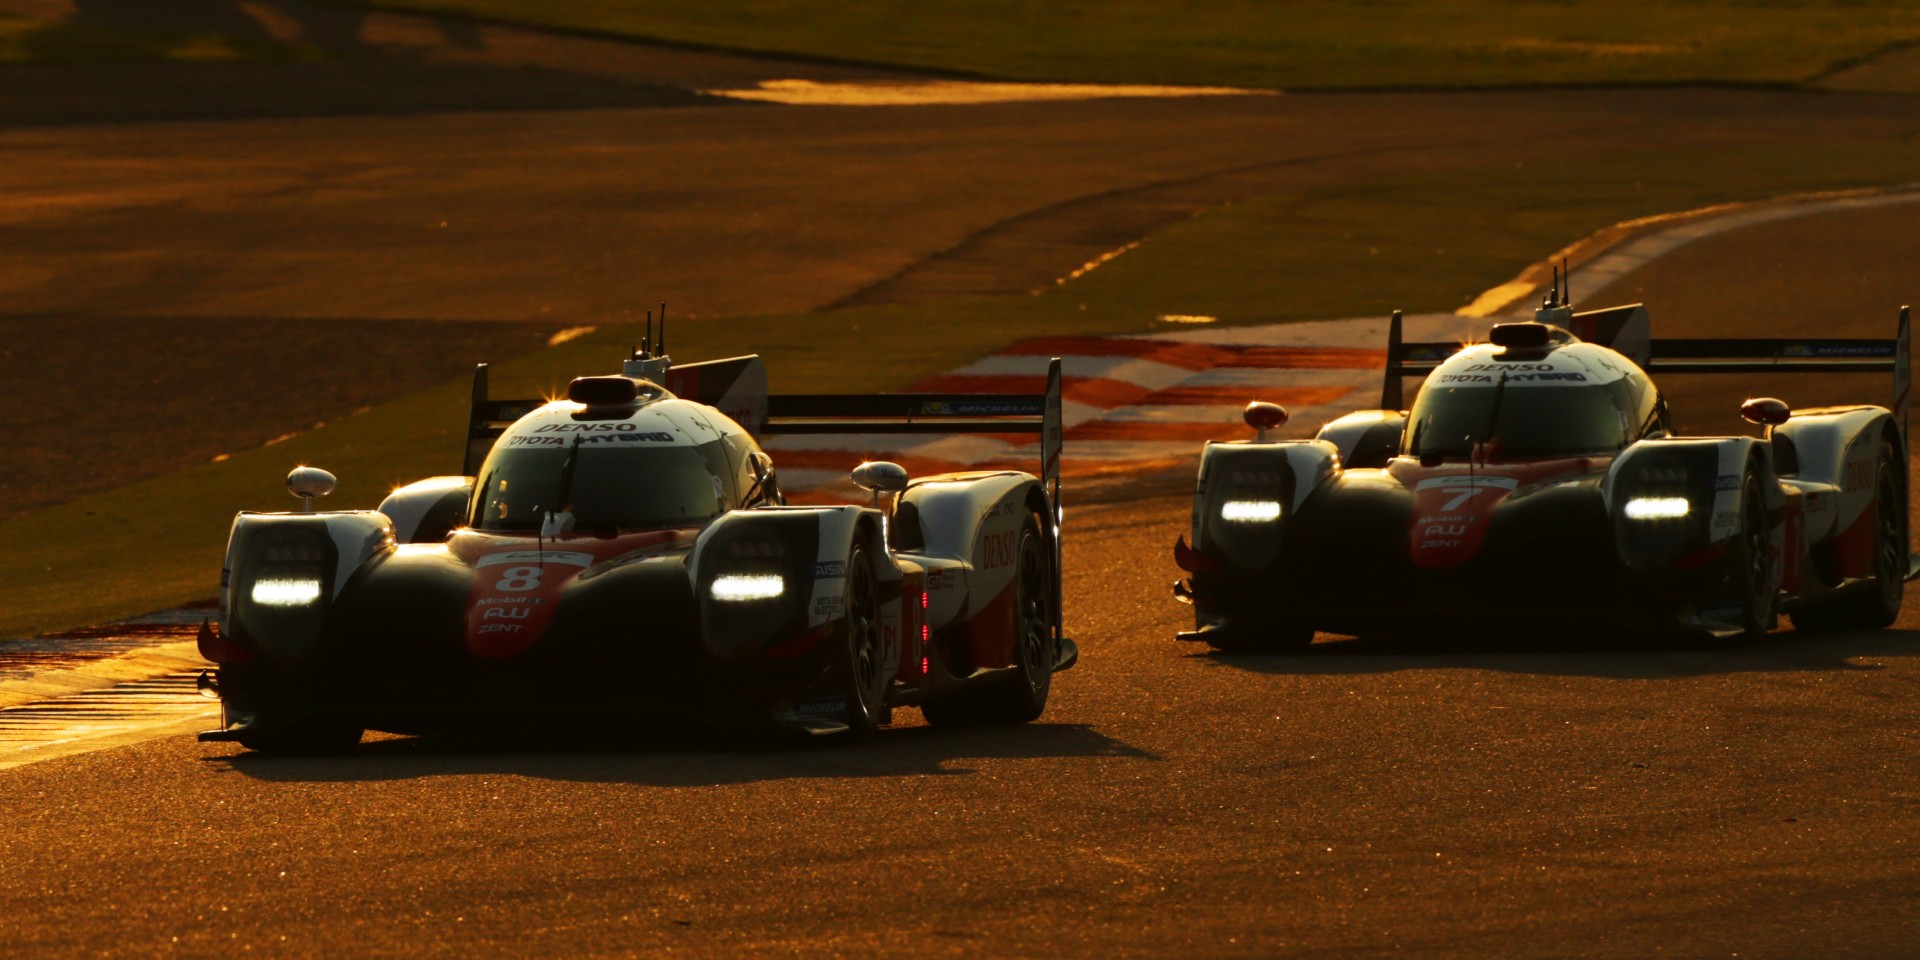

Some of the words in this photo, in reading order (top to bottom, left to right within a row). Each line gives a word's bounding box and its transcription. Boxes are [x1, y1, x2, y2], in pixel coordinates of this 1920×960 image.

[1463, 364, 1555, 372] DENSO
[1438, 374, 1491, 383] TOYOTA
[1503, 372, 1587, 382] HYBRID
[957, 404, 1041, 412] MICHELIN
[534, 423, 637, 433] DENSO
[508, 435, 565, 446] TOYOTA
[577, 432, 674, 444] HYBRID
[1440, 487, 1484, 512] 7
[1417, 516, 1462, 525] Mobil
[1420, 539, 1462, 549] ZENT
[984, 530, 1016, 570] DENSO
[815, 564, 846, 577] AISIN
[495, 566, 544, 592] 8
[476, 596, 527, 607] Mobil
[477, 623, 525, 635] ZENT
